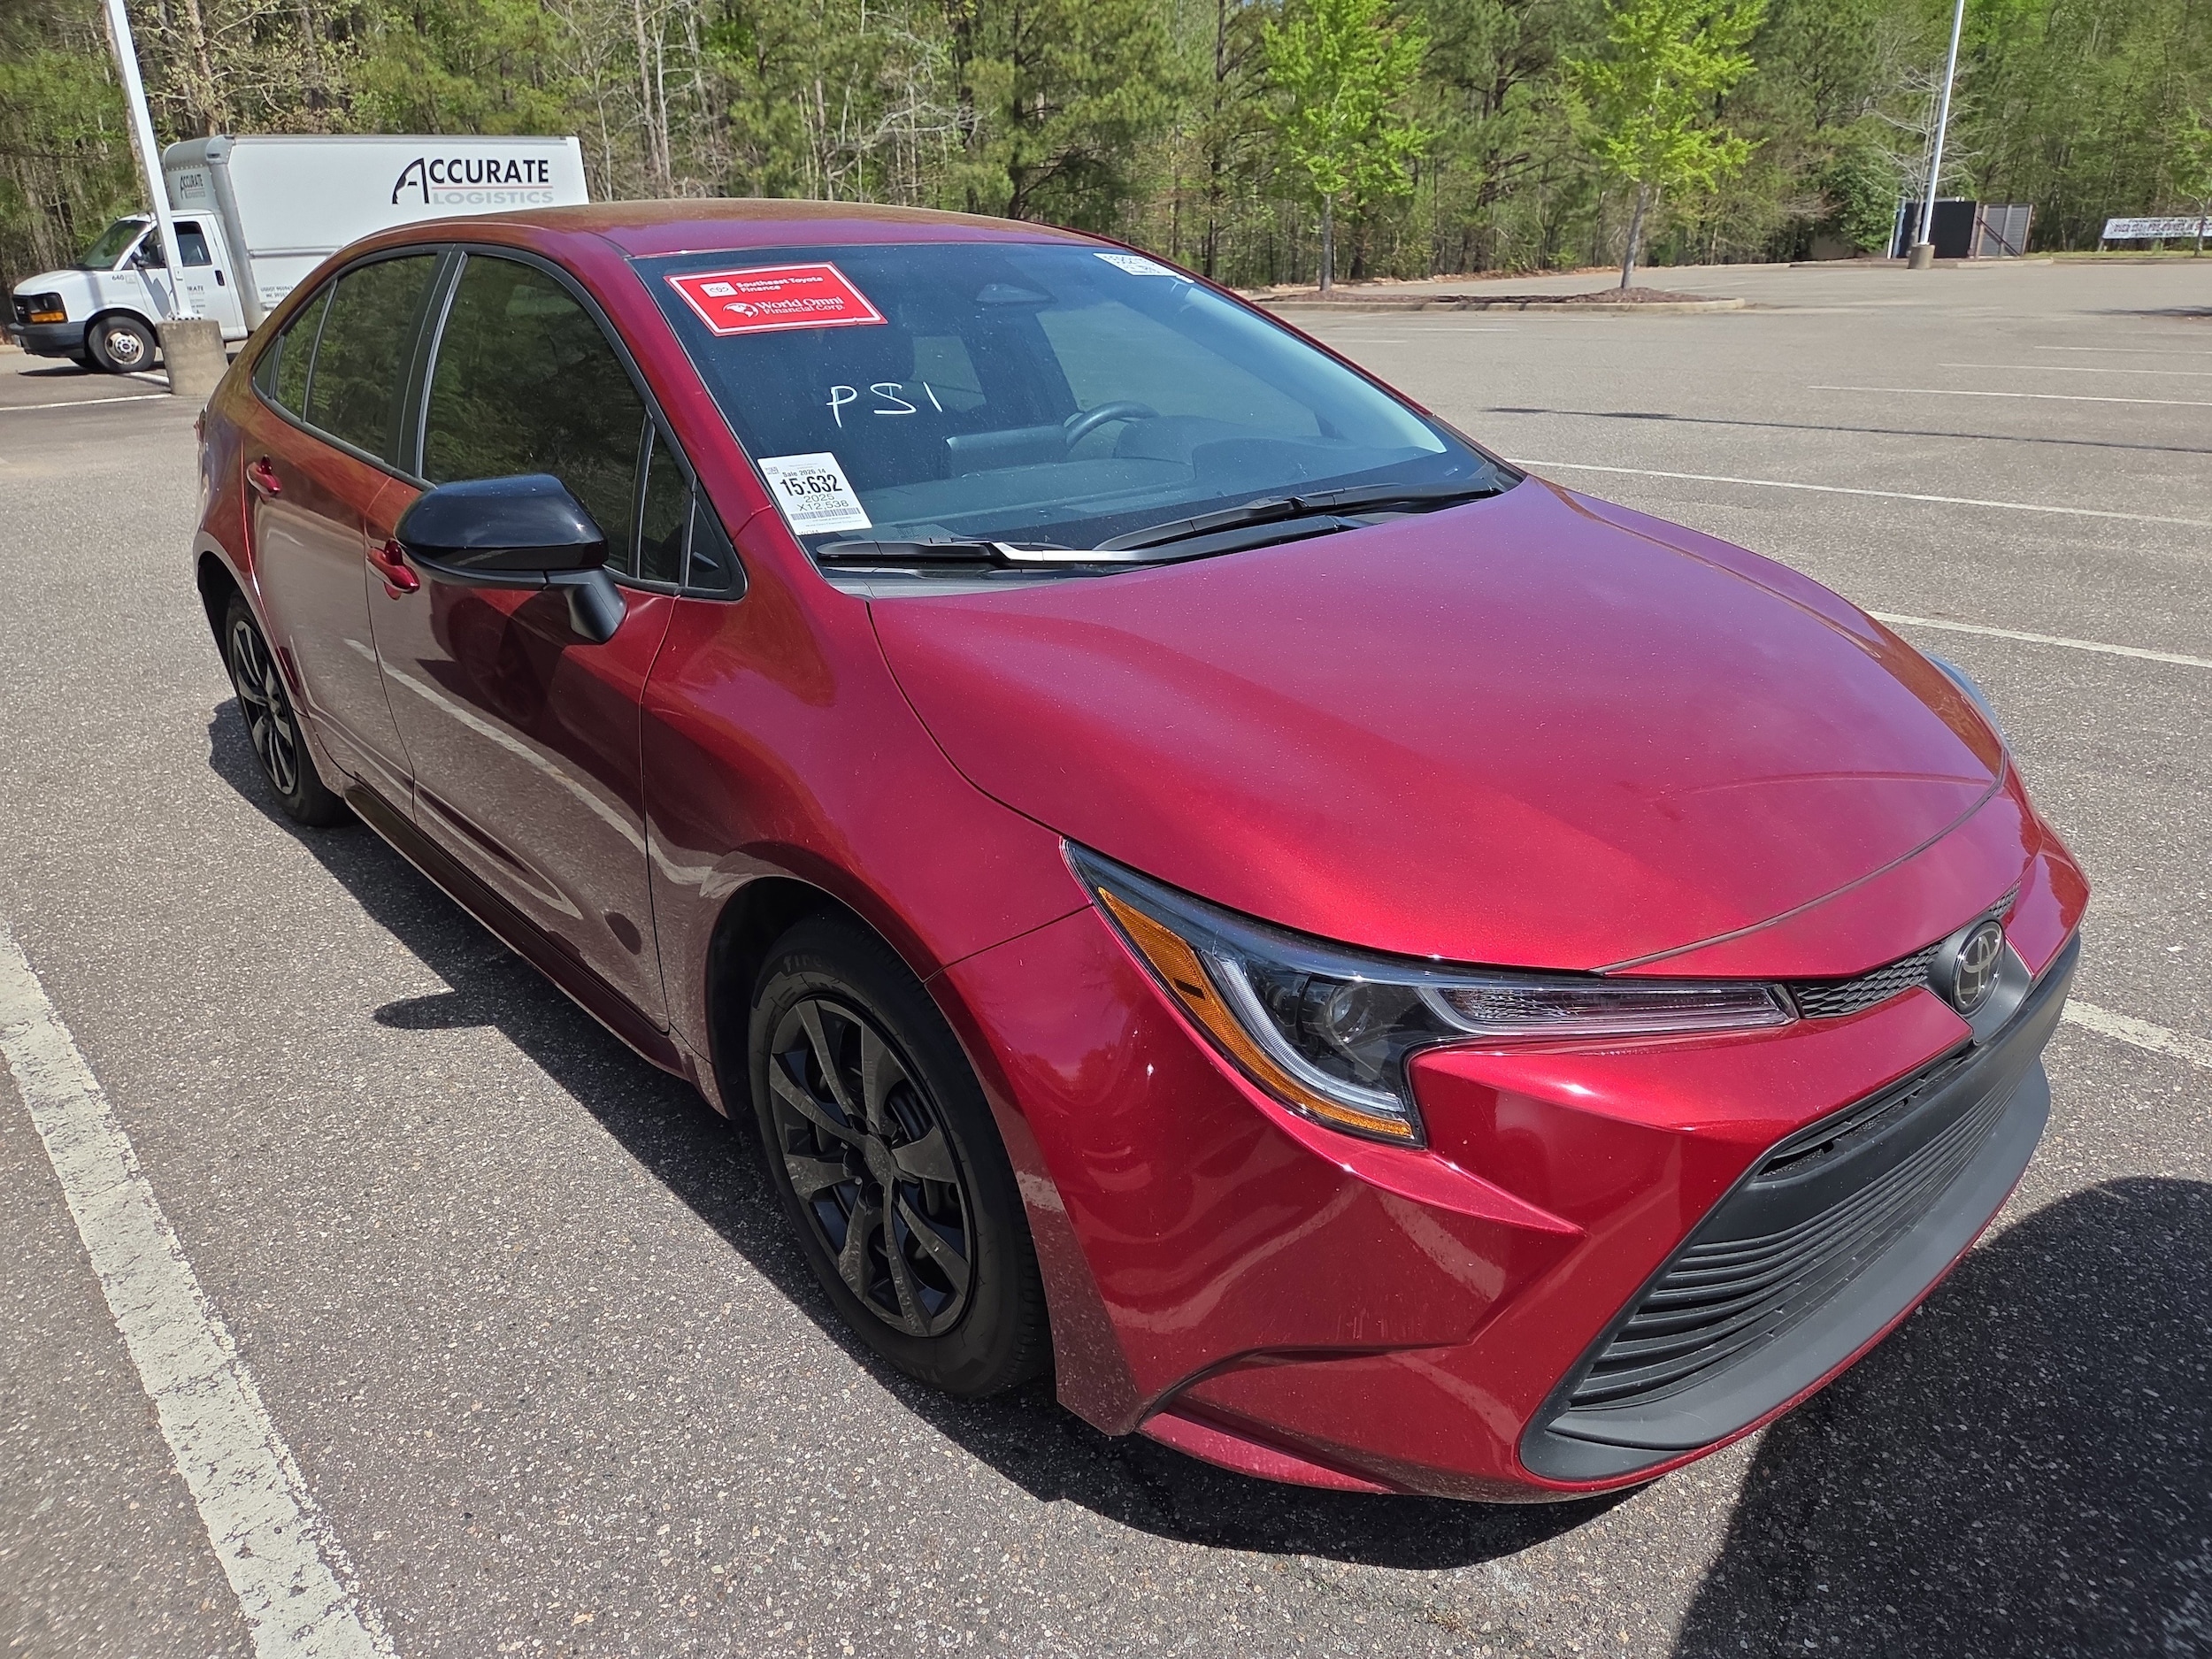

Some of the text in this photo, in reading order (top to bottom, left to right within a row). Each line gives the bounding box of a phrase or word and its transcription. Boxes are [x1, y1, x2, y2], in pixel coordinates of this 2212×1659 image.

[392, 157, 549, 204] ACCURATE
[434, 191, 554, 204] LOGISTICS
[736, 279, 788, 288] Southeast
[755, 296, 843, 310] World Omni
[764, 303, 846, 315] Financial Corp.
[780, 474, 842, 495] 15:632
[803, 494, 835, 503] 2025
